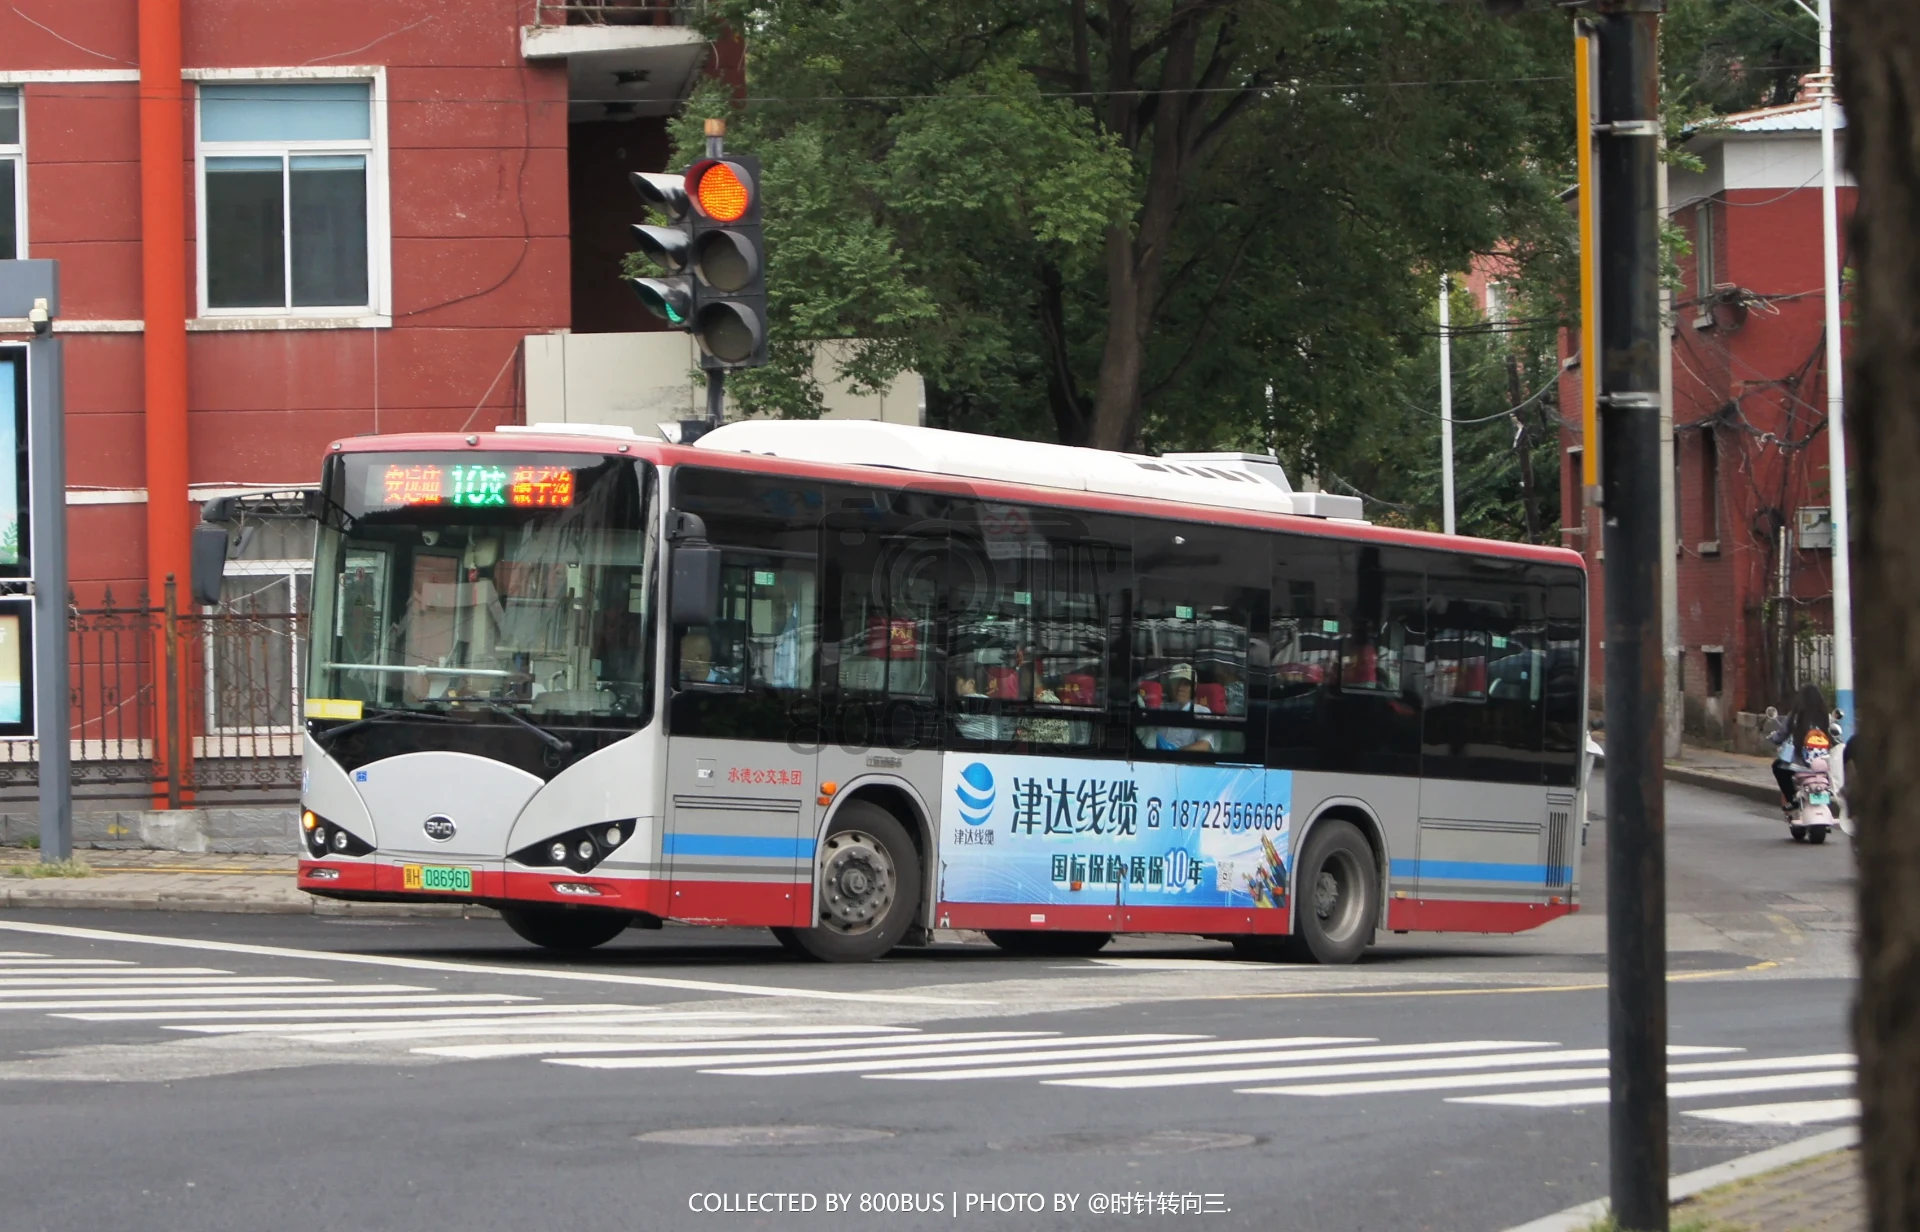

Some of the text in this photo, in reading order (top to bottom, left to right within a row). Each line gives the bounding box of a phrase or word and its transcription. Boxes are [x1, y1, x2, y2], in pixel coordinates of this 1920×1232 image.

[727, 767, 802, 786] 承德公交集团
[1011, 777, 1139, 835] 津达线缆
[1171, 799, 1283, 831] 18722556666
[426, 821, 452, 834] BYD
[954, 828, 994, 845] 津达线缆
